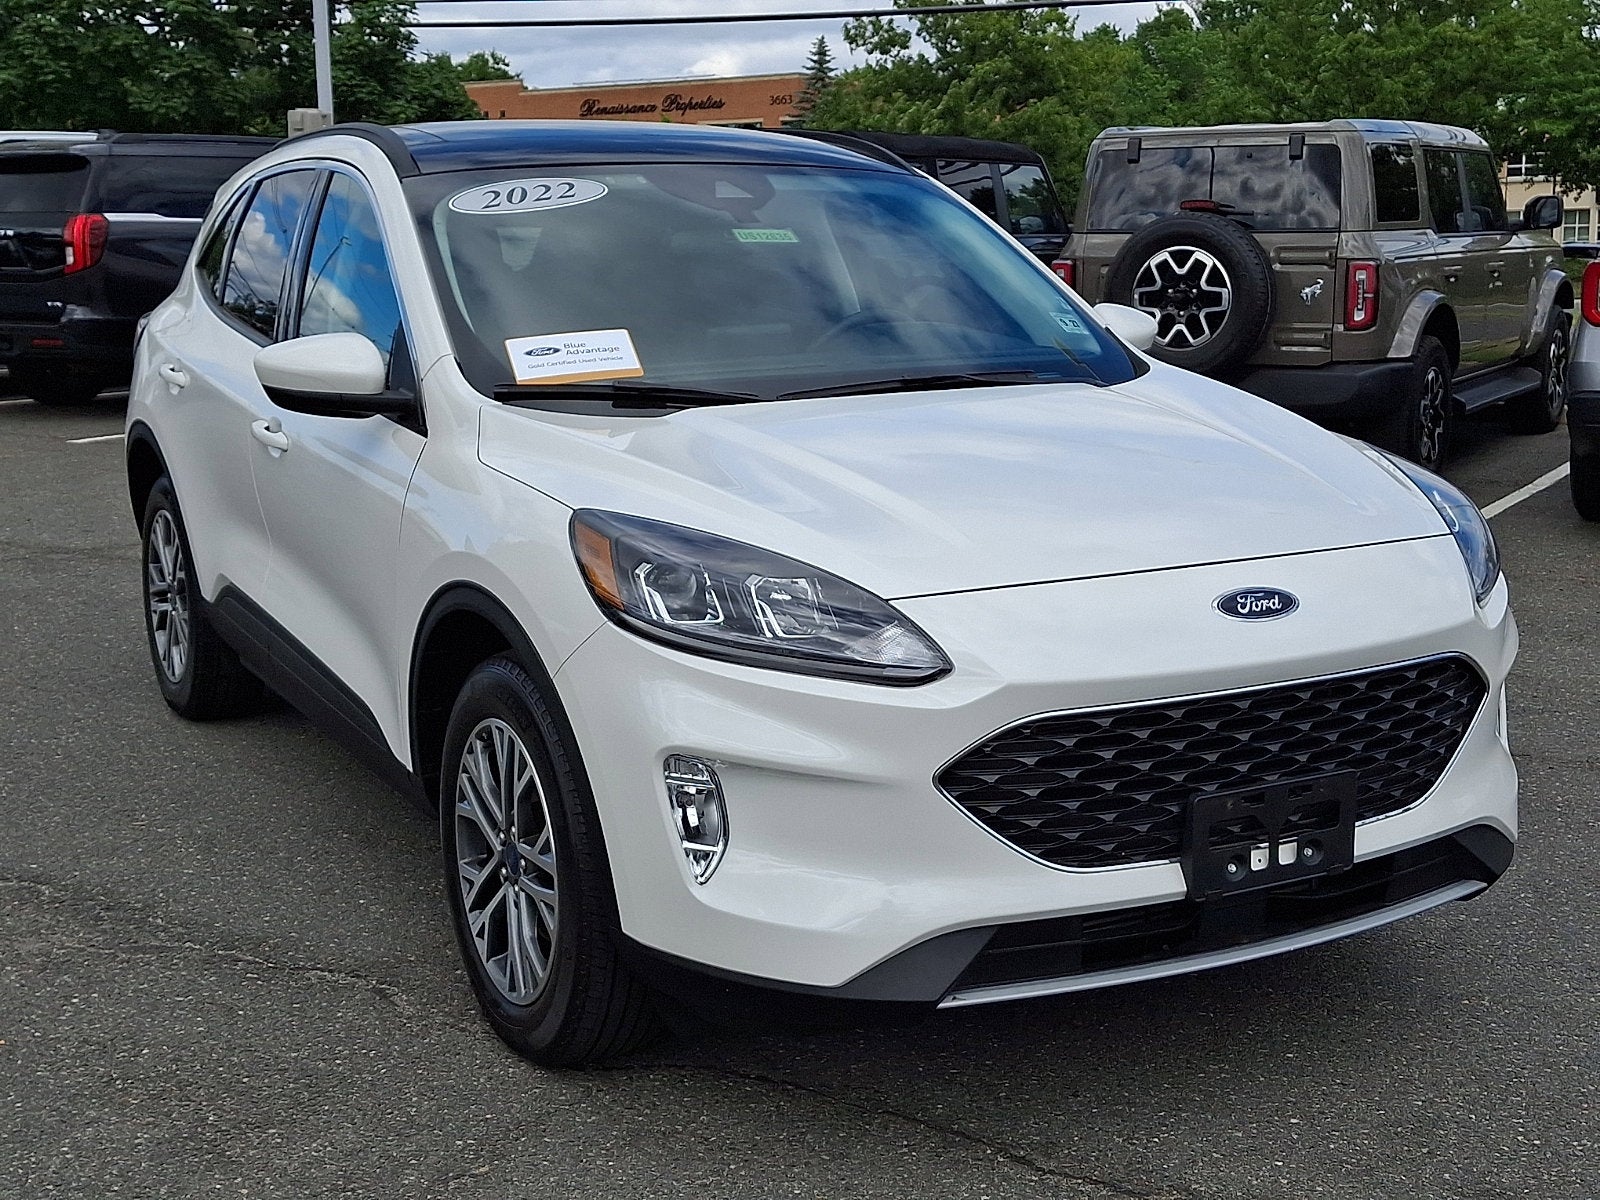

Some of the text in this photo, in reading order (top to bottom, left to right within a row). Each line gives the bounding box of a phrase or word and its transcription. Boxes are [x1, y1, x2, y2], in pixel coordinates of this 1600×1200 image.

[579, 93, 725, 117] Renaissance Properties
[769, 95, 793, 106] 3663
[481, 182, 577, 210] 2022
[566, 346, 620, 356] Advantage
[546, 359, 577, 367] Certified
[1236, 592, 1283, 614] Ford
